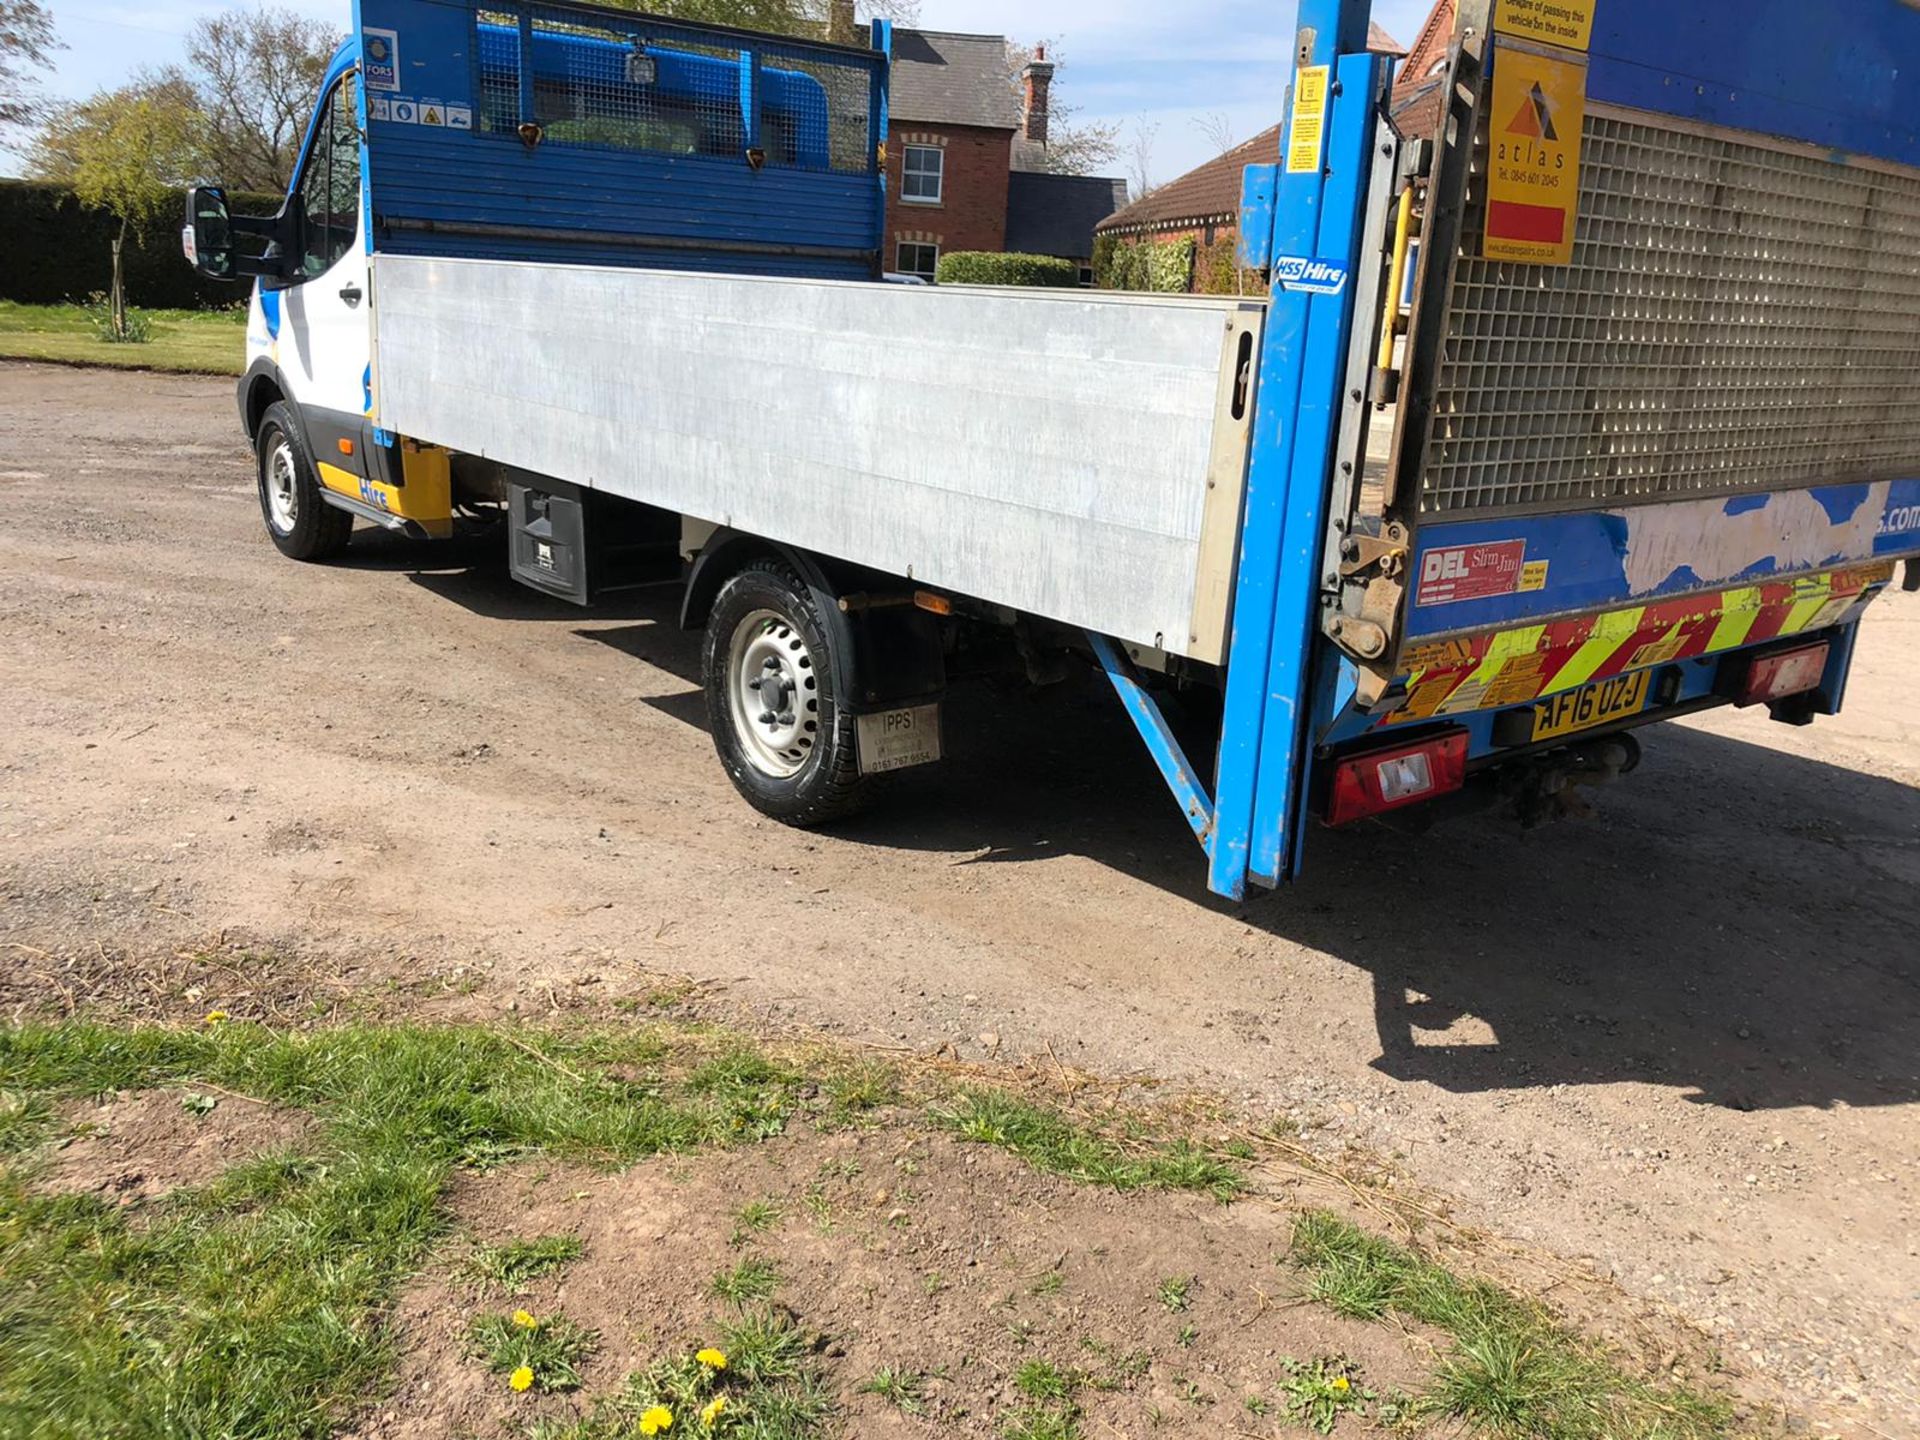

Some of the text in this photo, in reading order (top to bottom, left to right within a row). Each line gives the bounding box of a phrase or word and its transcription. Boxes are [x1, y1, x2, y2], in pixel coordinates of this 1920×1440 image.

[1534, 2, 1543, 12] of
[1542, 4, 1571, 21] passing
[1571, 10, 1585, 23] this
[1507, 14, 1533, 28] vehicle
[1545, 21, 1556, 34] the
[1557, 24, 1578, 39] inside
[366, 65, 392, 77] FORS
[1498, 141, 1563, 169] atlas
[1510, 169, 1527, 183] 0845
[1527, 172, 1540, 185] 601
[1541, 174, 1559, 188] 2045
[1278, 260, 1343, 282] HSS Hire
[359, 478, 388, 507] Hire
[1423, 548, 1519, 582] DEL Slim Jim
[1539, 684, 1597, 731] AF16
[887, 711, 911, 732] PPS
